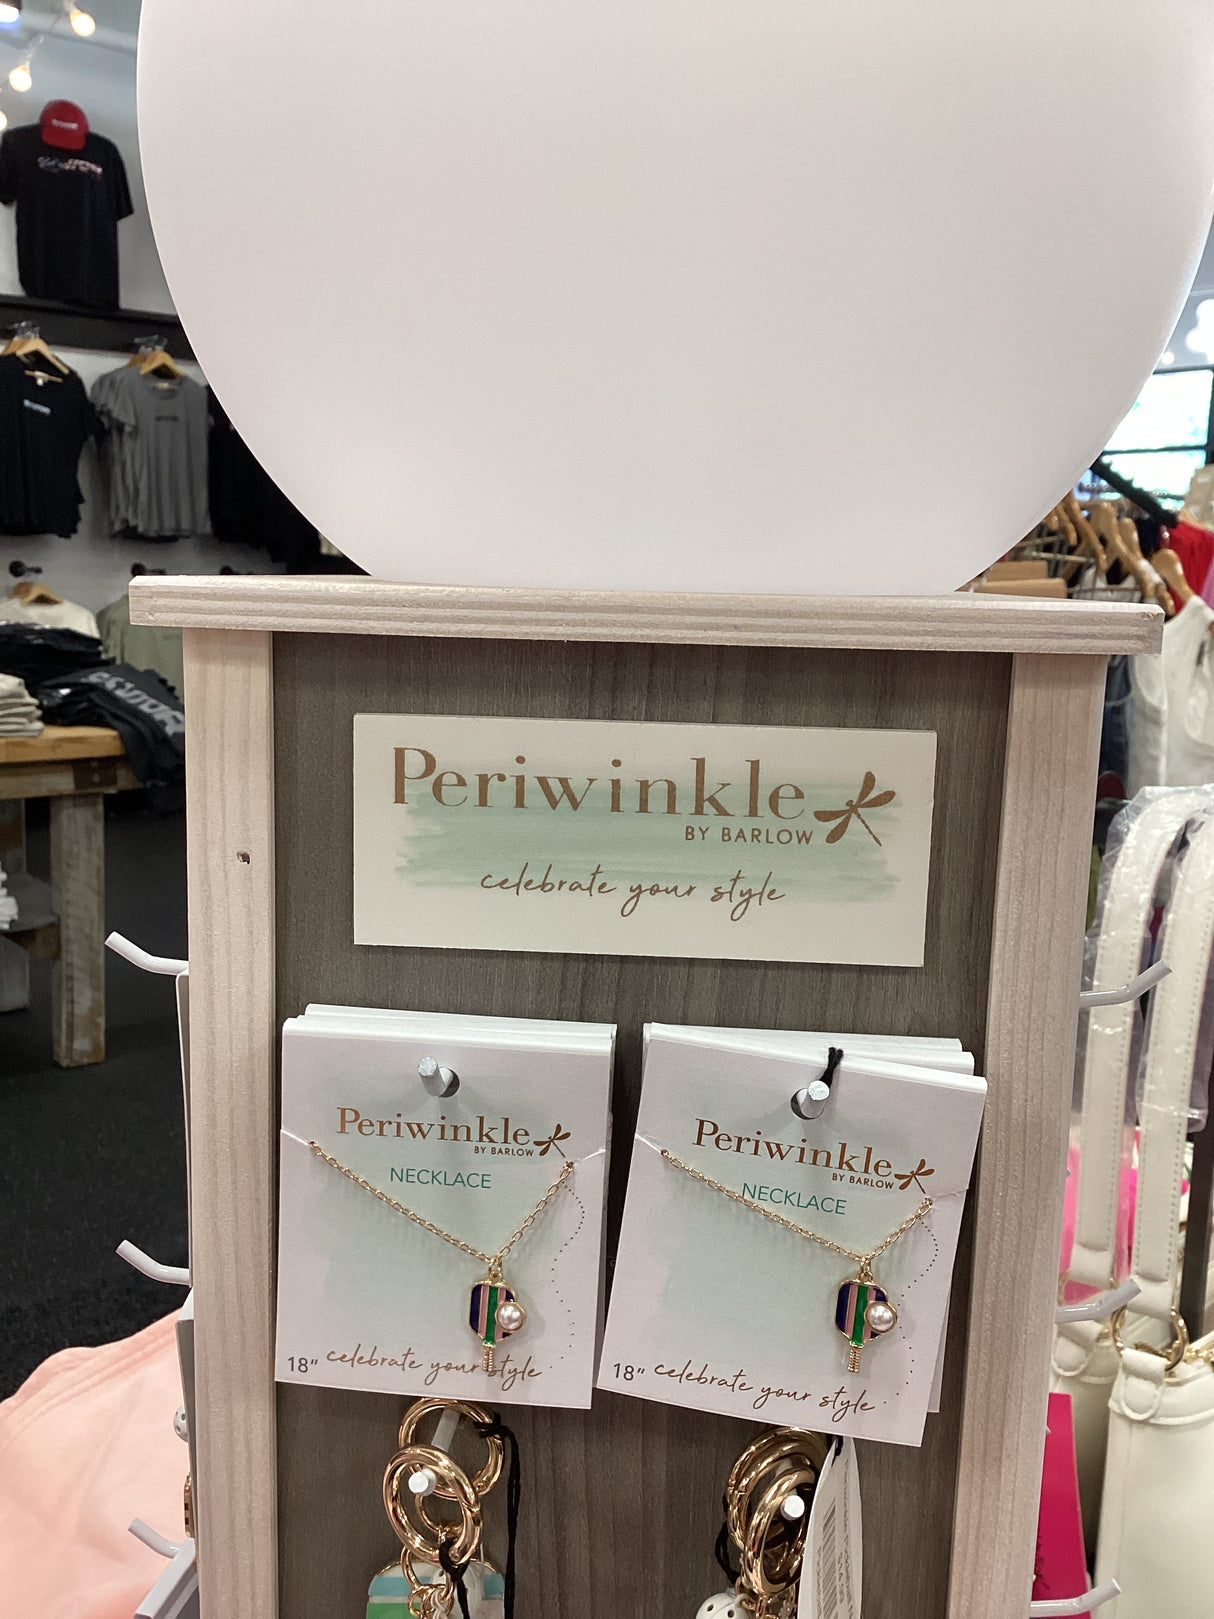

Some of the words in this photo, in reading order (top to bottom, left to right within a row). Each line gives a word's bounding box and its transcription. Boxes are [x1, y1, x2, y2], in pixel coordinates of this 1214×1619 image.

[393, 747, 805, 820] Periwinkle
[685, 825, 709, 841] BY
[721, 827, 813, 846] BARLOW
[480, 862, 617, 897] celebrate
[620, 882, 697, 917] your
[710, 870, 786, 922] style
[336, 1107, 531, 1146] Periwinkle
[474, 1146, 487, 1155] BY
[491, 1147, 534, 1157] BARLOW
[692, 1118, 893, 1178] Periwinkle
[390, 1167, 492, 1189] NECKLACE
[832, 1172, 844, 1182] BY
[849, 1175, 895, 1190] BARLOW
[742, 1182, 847, 1215] NECKLACE
[288, 1356, 319, 1373] 18"
[326, 1343, 423, 1372] celebrate
[424, 1360, 485, 1386] your
[613, 1363, 646, 1381] 18"
[654, 1360, 754, 1392] celebrate
[752, 1387, 812, 1410] your
[818, 1386, 876, 1423] style
